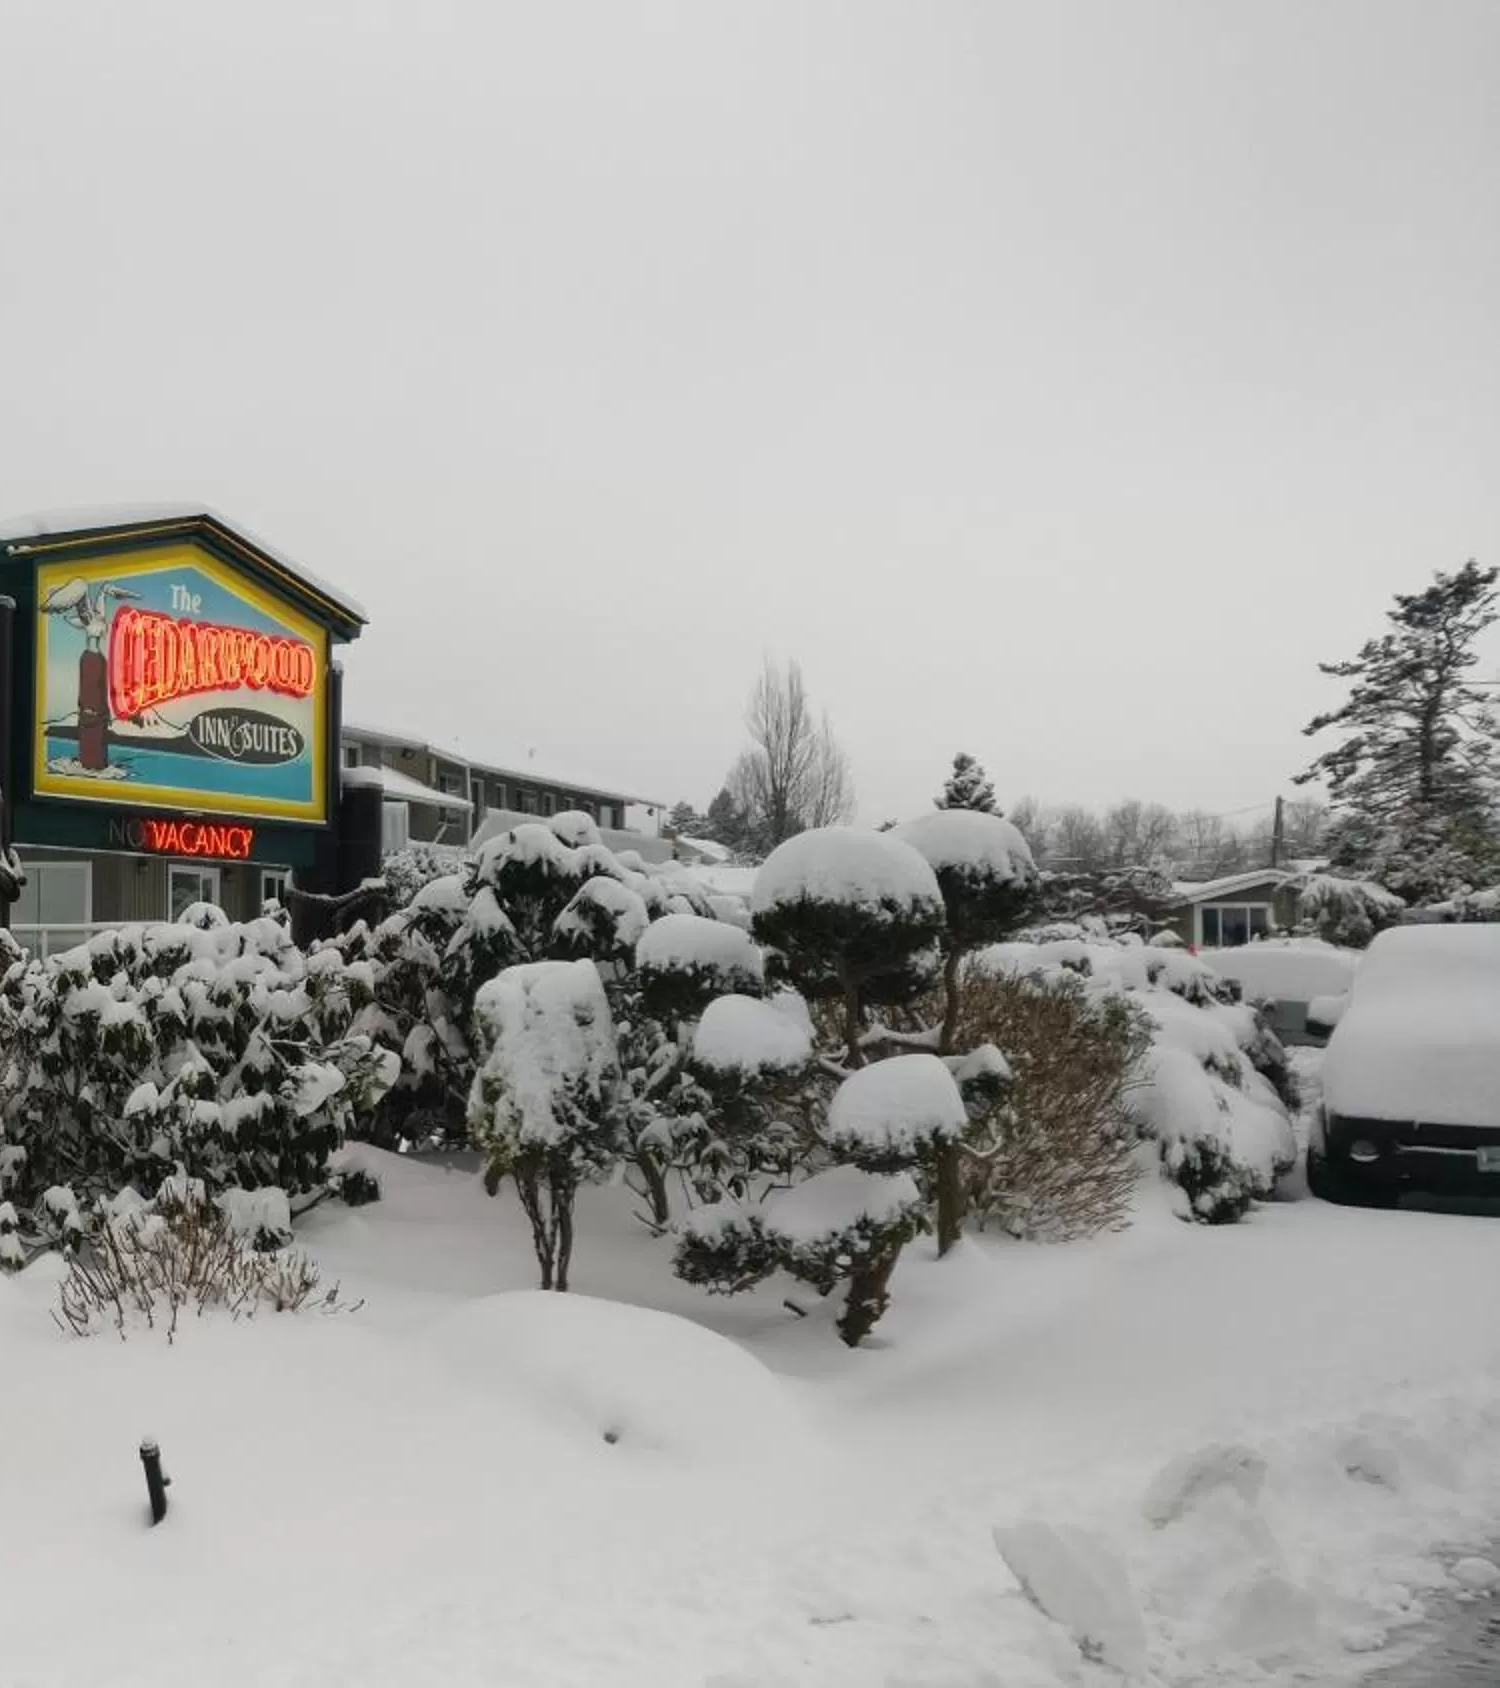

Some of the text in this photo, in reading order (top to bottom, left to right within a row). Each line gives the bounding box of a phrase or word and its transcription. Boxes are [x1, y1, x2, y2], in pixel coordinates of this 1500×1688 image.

[170, 584, 202, 613] The
[108, 604, 316, 720] CEDARWOOD
[198, 715, 230, 748] INN
[242, 721, 297, 757] SUITES
[149, 820, 253, 857] VACANCY
